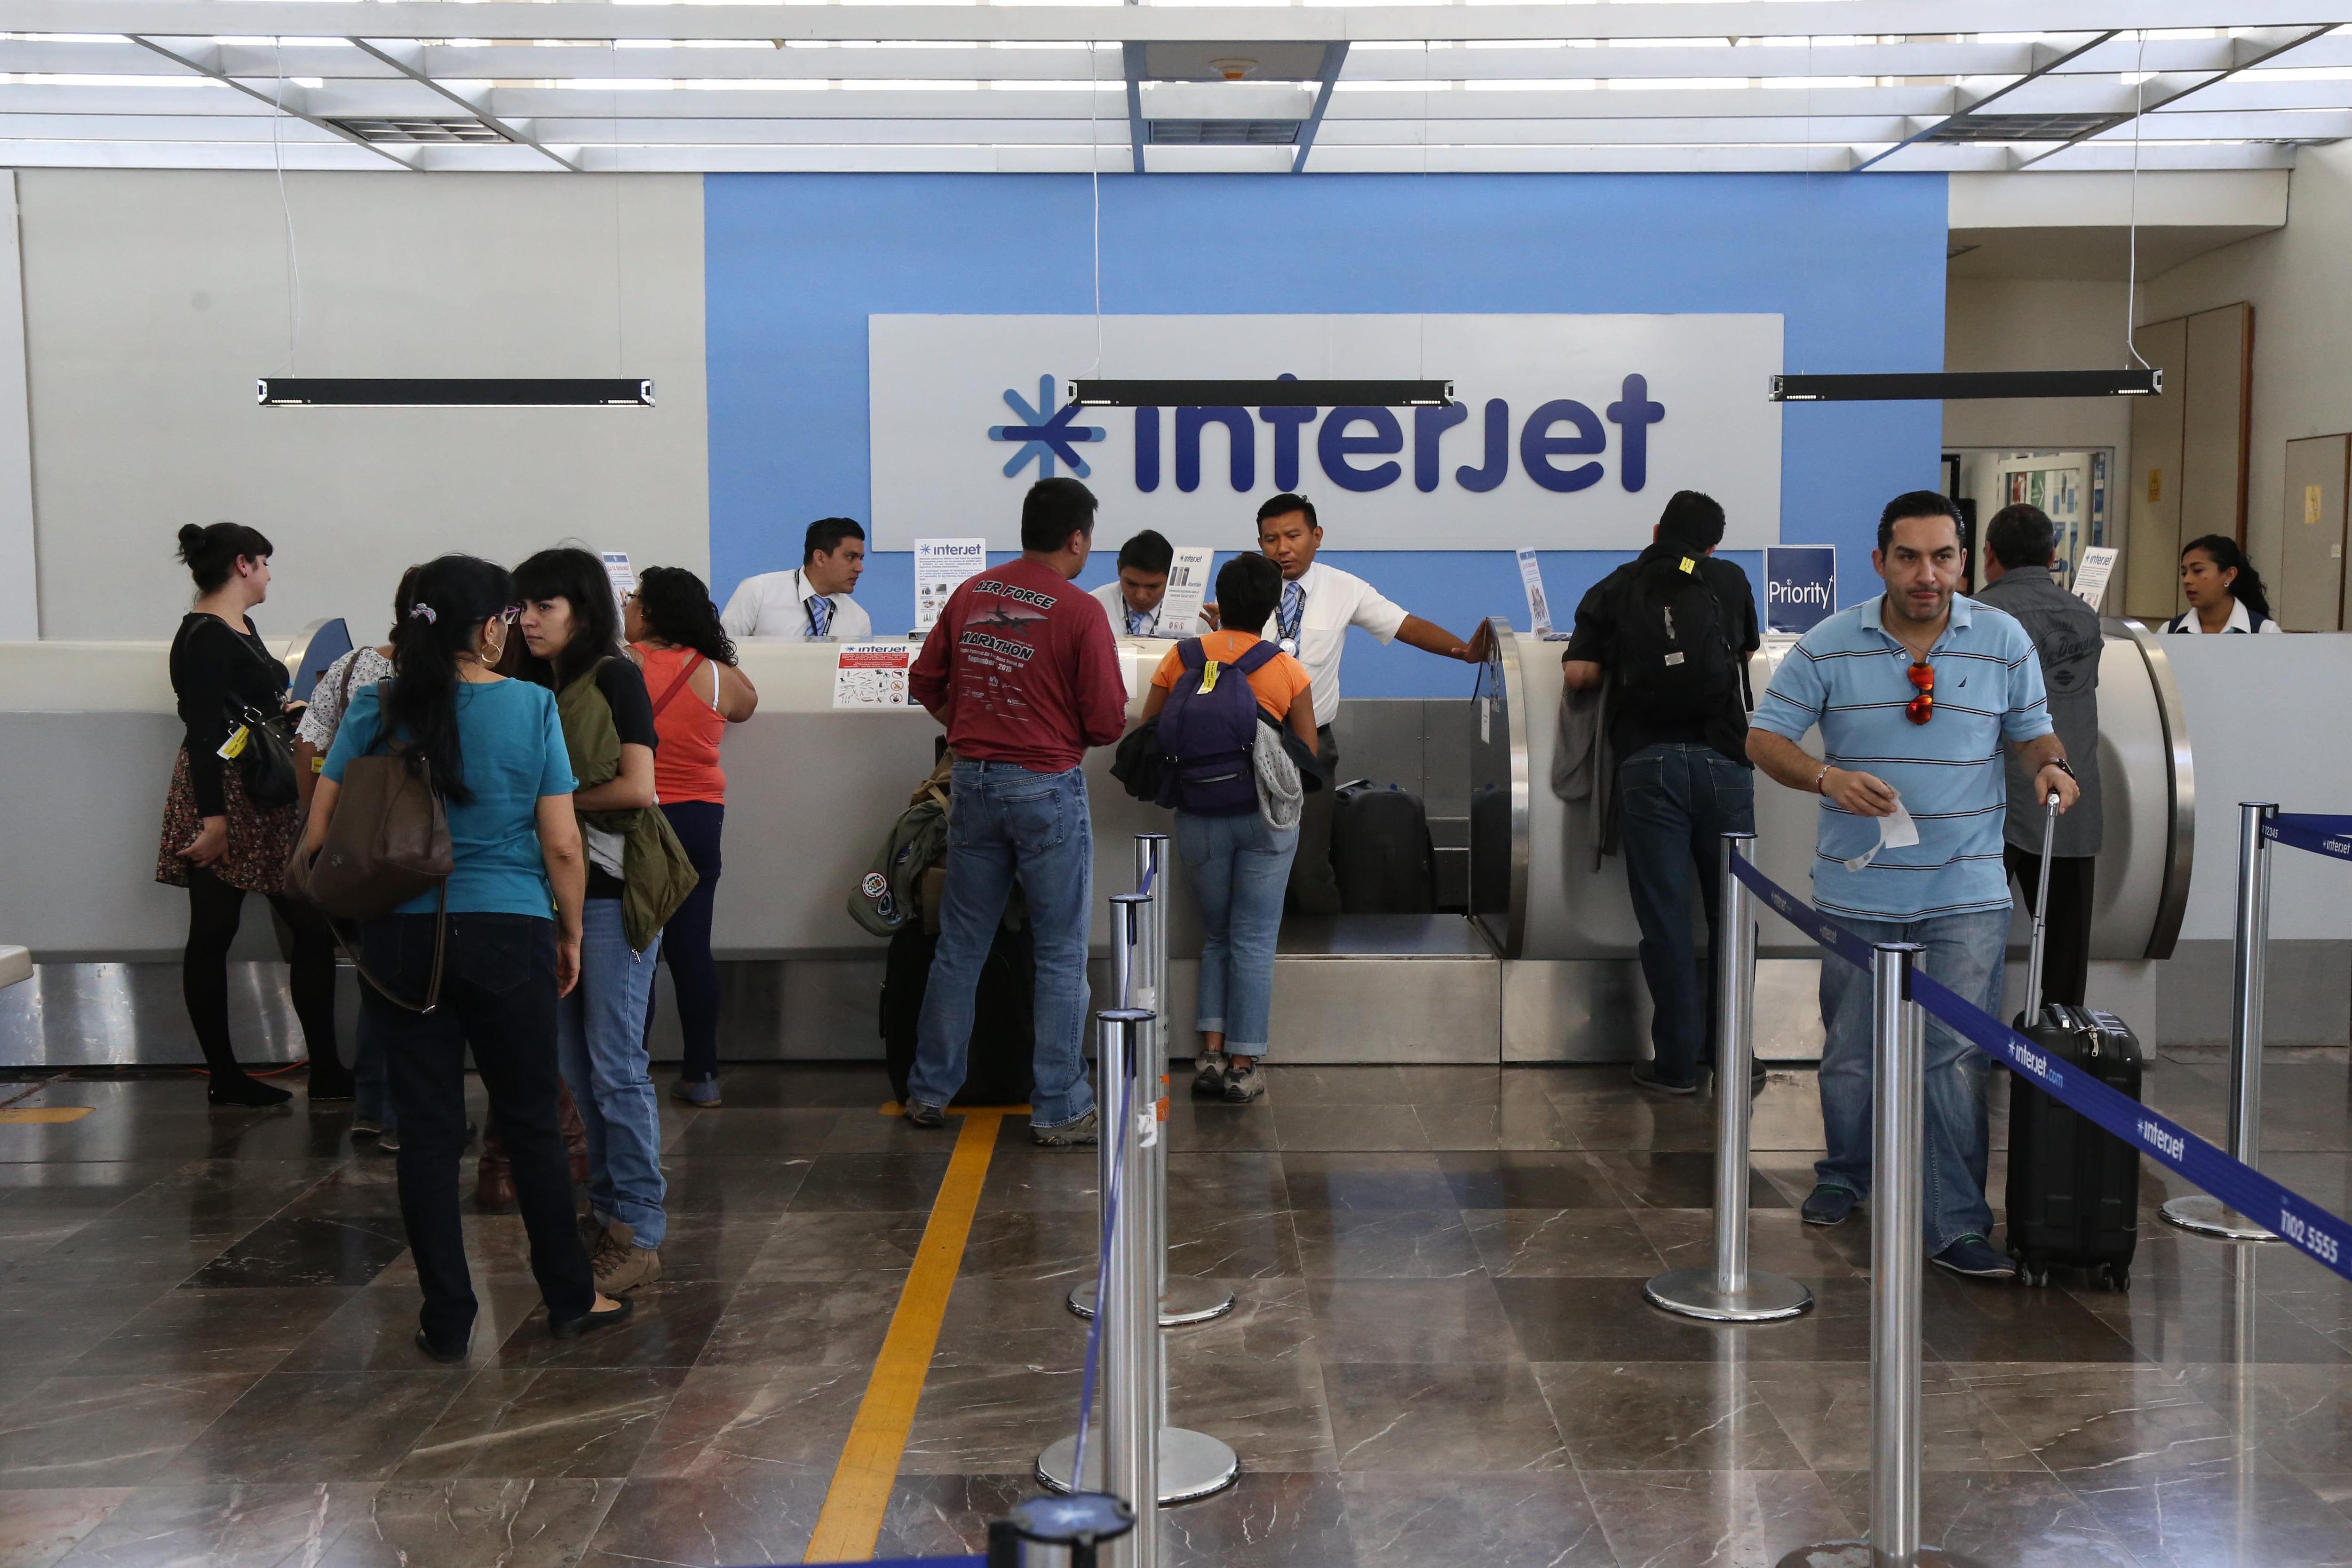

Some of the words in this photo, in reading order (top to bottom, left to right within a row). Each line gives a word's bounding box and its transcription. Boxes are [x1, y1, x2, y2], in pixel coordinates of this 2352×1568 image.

[1134, 373, 1665, 493] interjet
[933, 543, 981, 555] interjet
[2090, 554, 2113, 565] interjet
[972, 580, 1003, 595] AIR
[1001, 585, 1057, 609] FORCE
[1769, 576, 1833, 610] Priority
[959, 631, 1034, 661] MARATHON
[997, 663, 1012, 673] 2015
[2265, 826, 2278, 838] 12345
[2326, 839, 2351, 854] interjet
[2015, 1044, 2063, 1089] interjet.com
[2144, 1121, 2185, 1162] interjet
[2281, 1209, 2304, 1243] 1102
[2306, 1226, 2339, 1264] 5555
